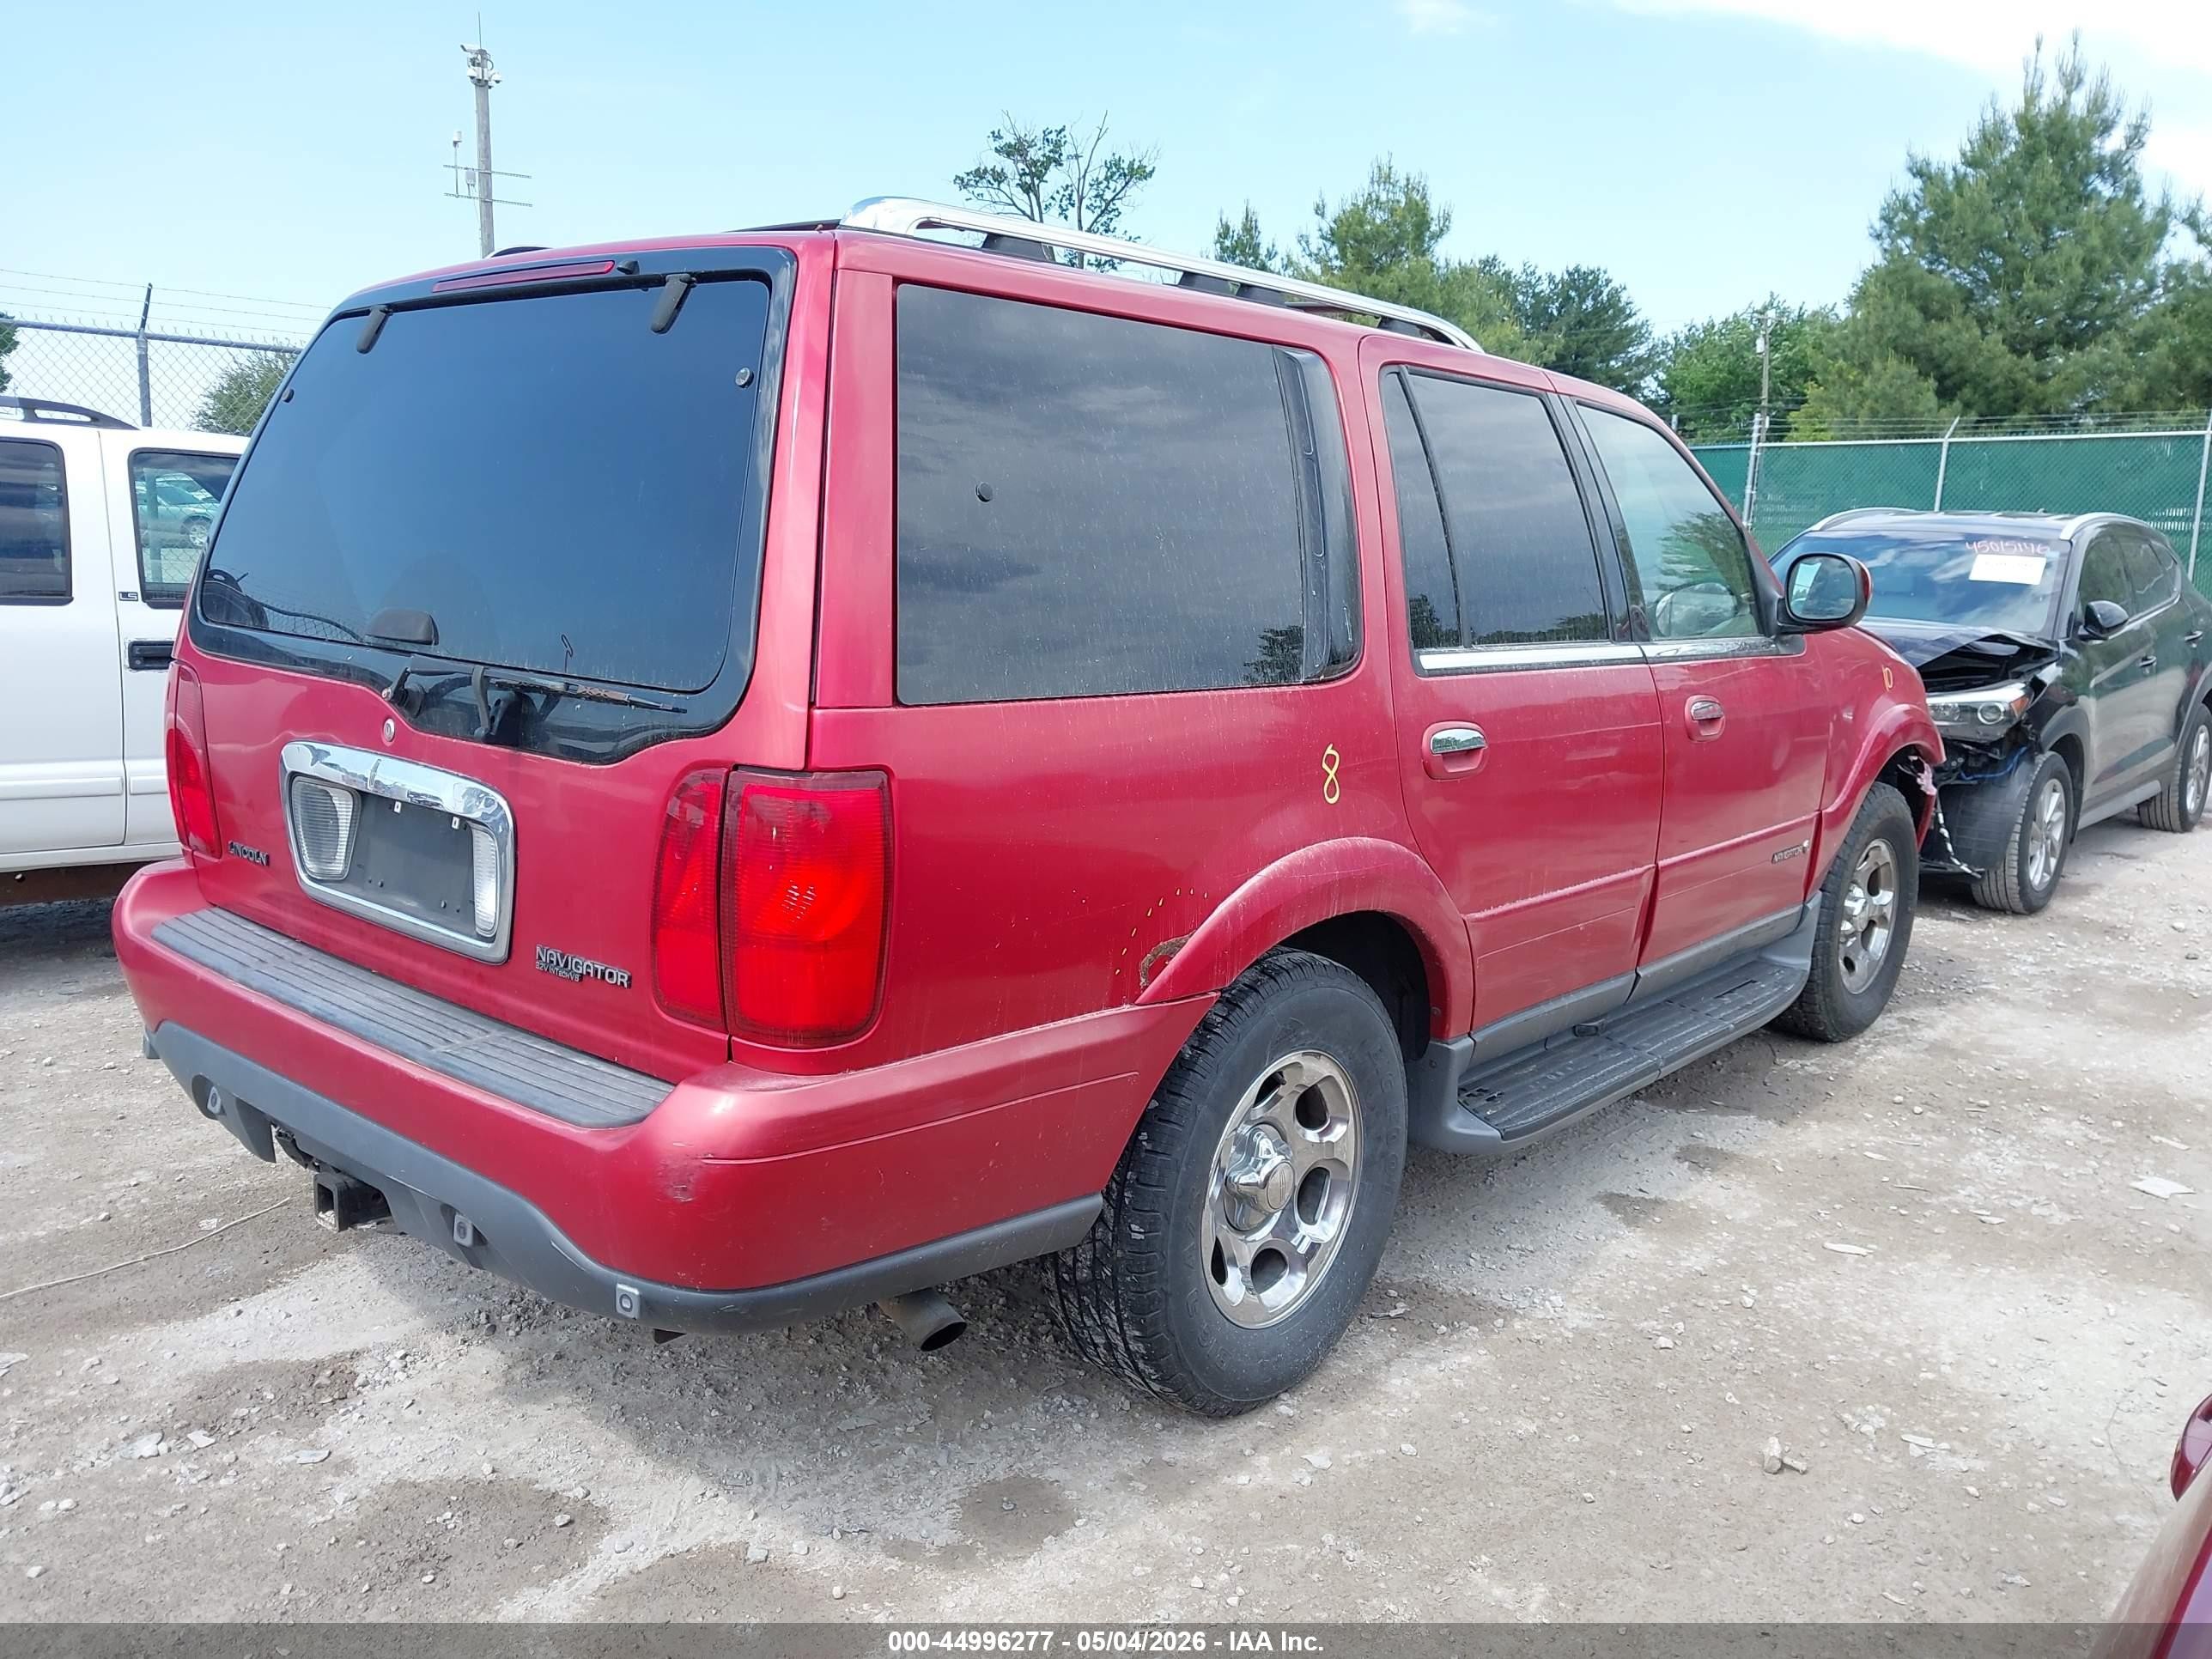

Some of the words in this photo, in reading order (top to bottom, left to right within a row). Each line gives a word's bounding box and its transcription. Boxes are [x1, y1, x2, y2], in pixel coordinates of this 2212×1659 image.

[118, 592, 138, 601] LS
[1322, 743, 1340, 805] 8
[228, 841, 270, 866] LINCOLN
[536, 945, 630, 988] NAVIGATOR
